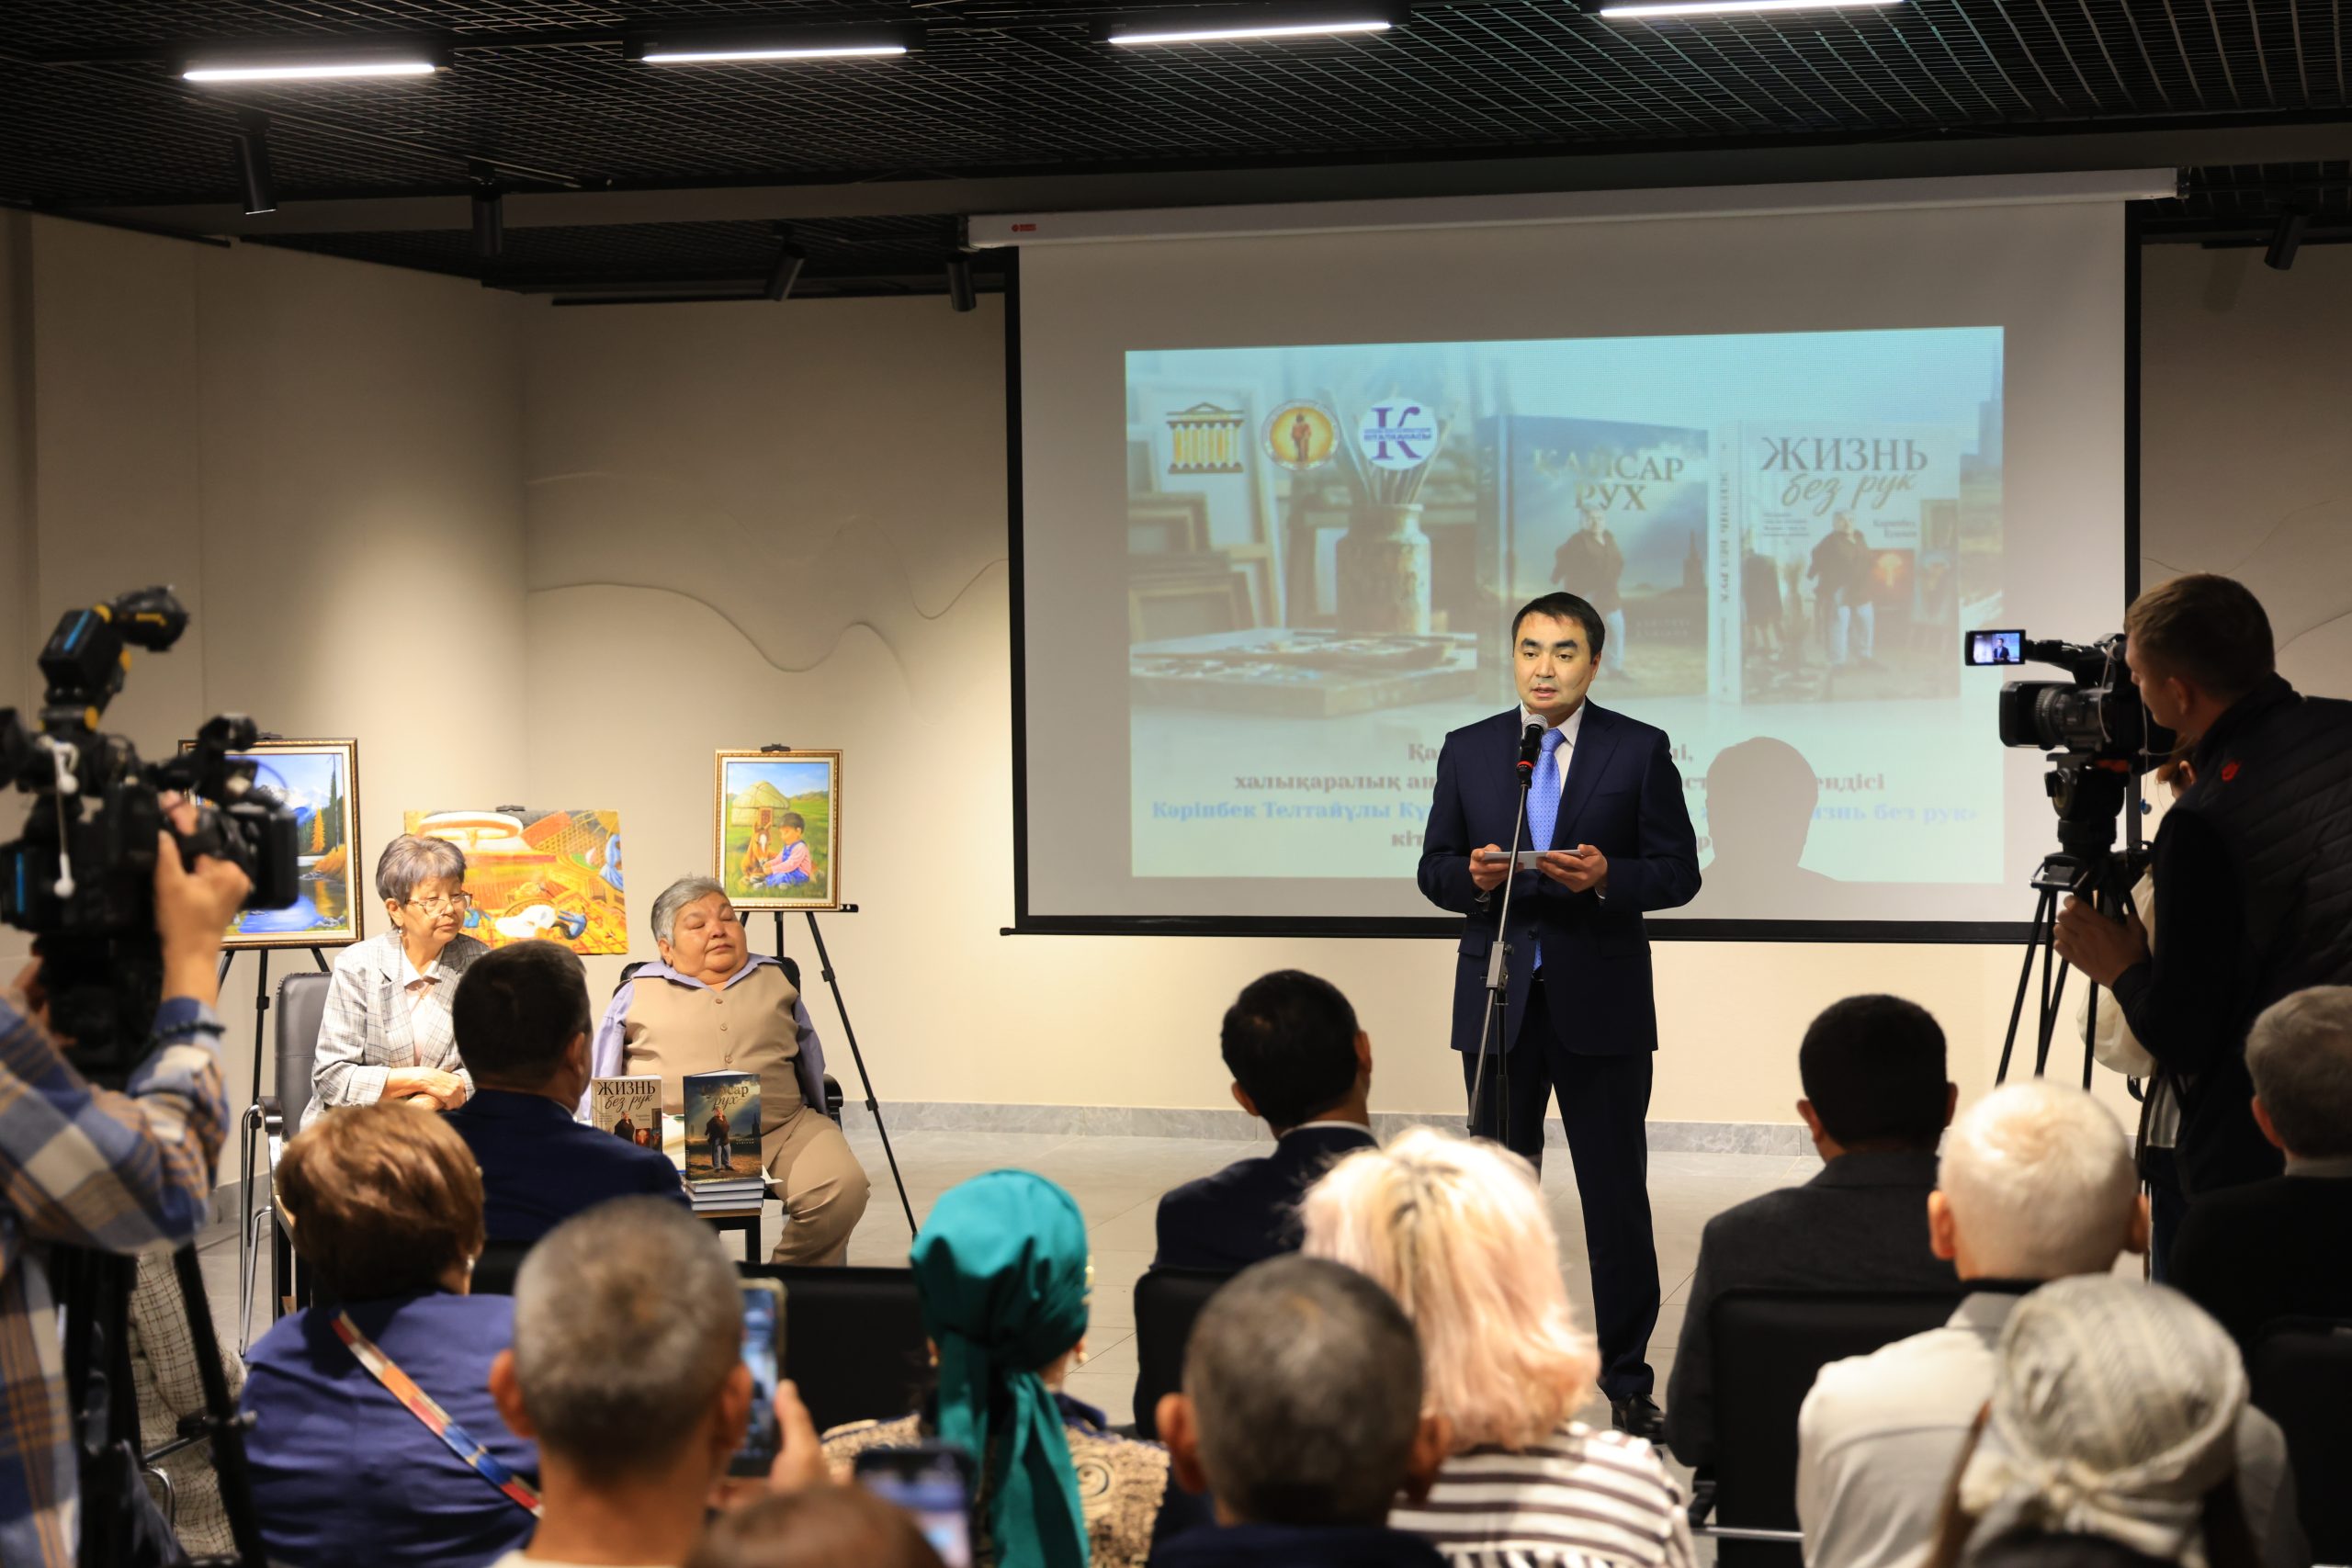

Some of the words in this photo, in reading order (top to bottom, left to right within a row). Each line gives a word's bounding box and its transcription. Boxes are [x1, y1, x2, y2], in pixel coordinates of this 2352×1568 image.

[1760, 436, 1928, 472] ЖИЗНЬ
[1781, 473, 1841, 516] без
[1851, 474, 1917, 509] рук
[597, 1080, 656, 1096] ЖИЗНЬ
[605, 1095, 626, 1112] без
[628, 1094, 653, 1111] рук
